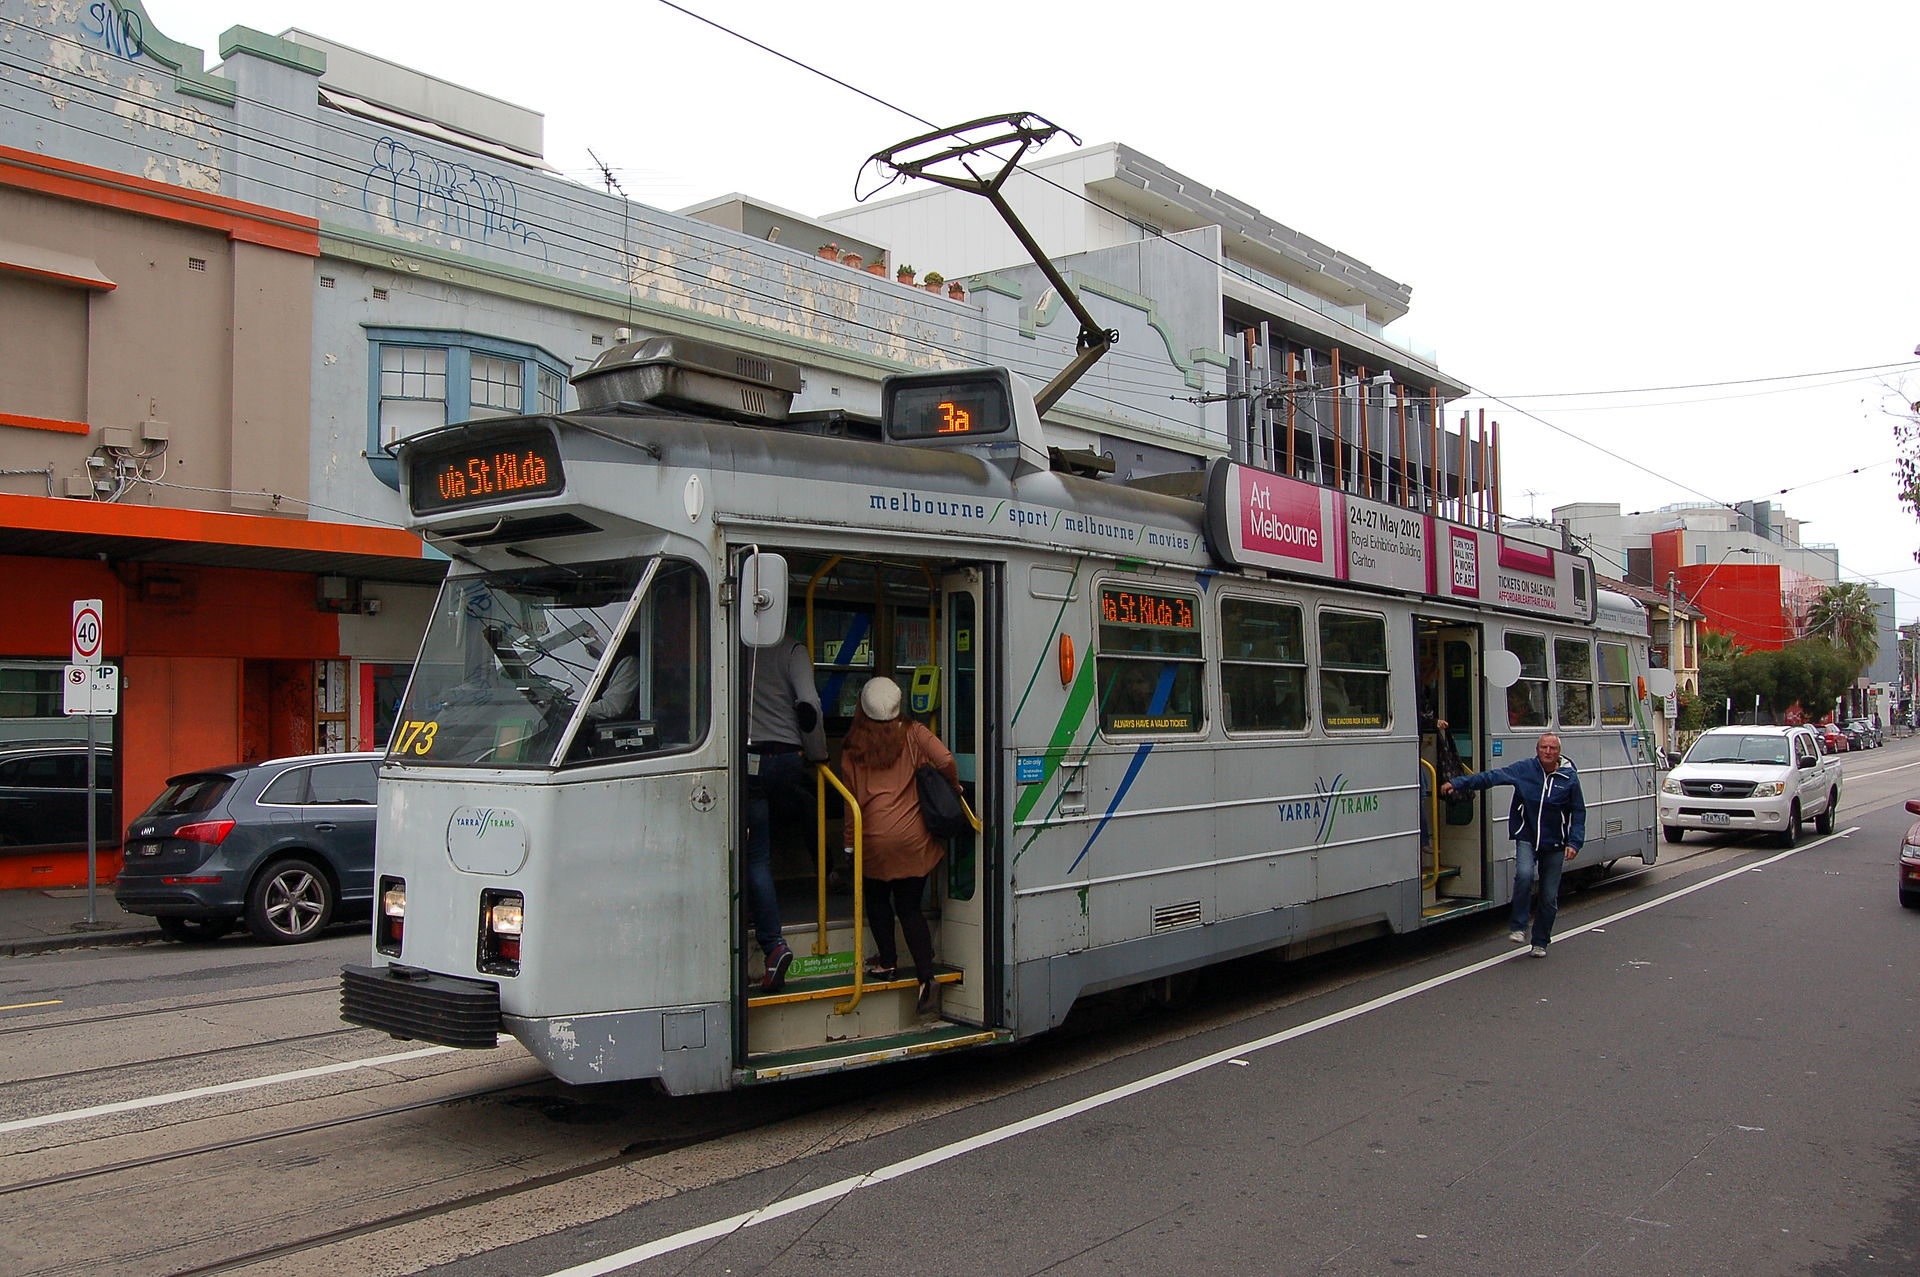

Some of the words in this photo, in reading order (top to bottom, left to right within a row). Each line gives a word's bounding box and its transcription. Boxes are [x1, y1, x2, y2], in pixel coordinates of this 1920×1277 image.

[938, 403, 969, 433] 3a
[438, 465, 466, 500] via
[467, 458, 493, 495] St
[495, 451, 546, 491] Kilda
[1250, 481, 1271, 511] Art
[869, 492, 985, 519] melbourne
[1009, 508, 1049, 528] sport
[1065, 516, 1135, 541] melbourne
[1148, 531, 1189, 550] movies
[1250, 509, 1318, 548] Melbourne
[1350, 506, 1378, 529] 24-27
[1380, 513, 1399, 539] May
[1400, 518, 1421, 539] 2012
[1351, 531, 1369, 549] Royal
[1370, 535, 1398, 553] Exhibition
[1399, 541, 1421, 562] Building
[1454, 539, 1464, 549] TURN
[1464, 542, 1474, 551] YOUR
[1454, 549, 1464, 559] WALL
[1465, 552, 1474, 561] INTO
[1351, 551, 1376, 568] Carlton
[1455, 559, 1459, 570] A
[1459, 560, 1474, 573] WORK
[1455, 571, 1463, 584] OF
[1464, 574, 1475, 587] ART
[1498, 575, 1521, 591] TICKETS
[1521, 580, 1529, 592] ON
[1530, 582, 1543, 596] SALE
[1543, 584, 1556, 598] NOW
[1120, 593, 1137, 623] St
[1139, 595, 1172, 626] Kilda
[1176, 599, 1193, 628] 3a
[78, 622, 97, 643] 40
[72, 671, 82, 683] S
[96, 667, 114, 679] 1P
[1113, 719, 1135, 729] ALWAYS
[1136, 719, 1150, 728] HAVE
[1150, 719, 1155, 728] A
[1155, 719, 1169, 728] VALID
[393, 720, 438, 755] 173
[1278, 801, 1321, 822] YARRA
[1340, 795, 1379, 814] TRAMS
[457, 818, 480, 826] YARRA
[490, 819, 515, 828] TRAMS
